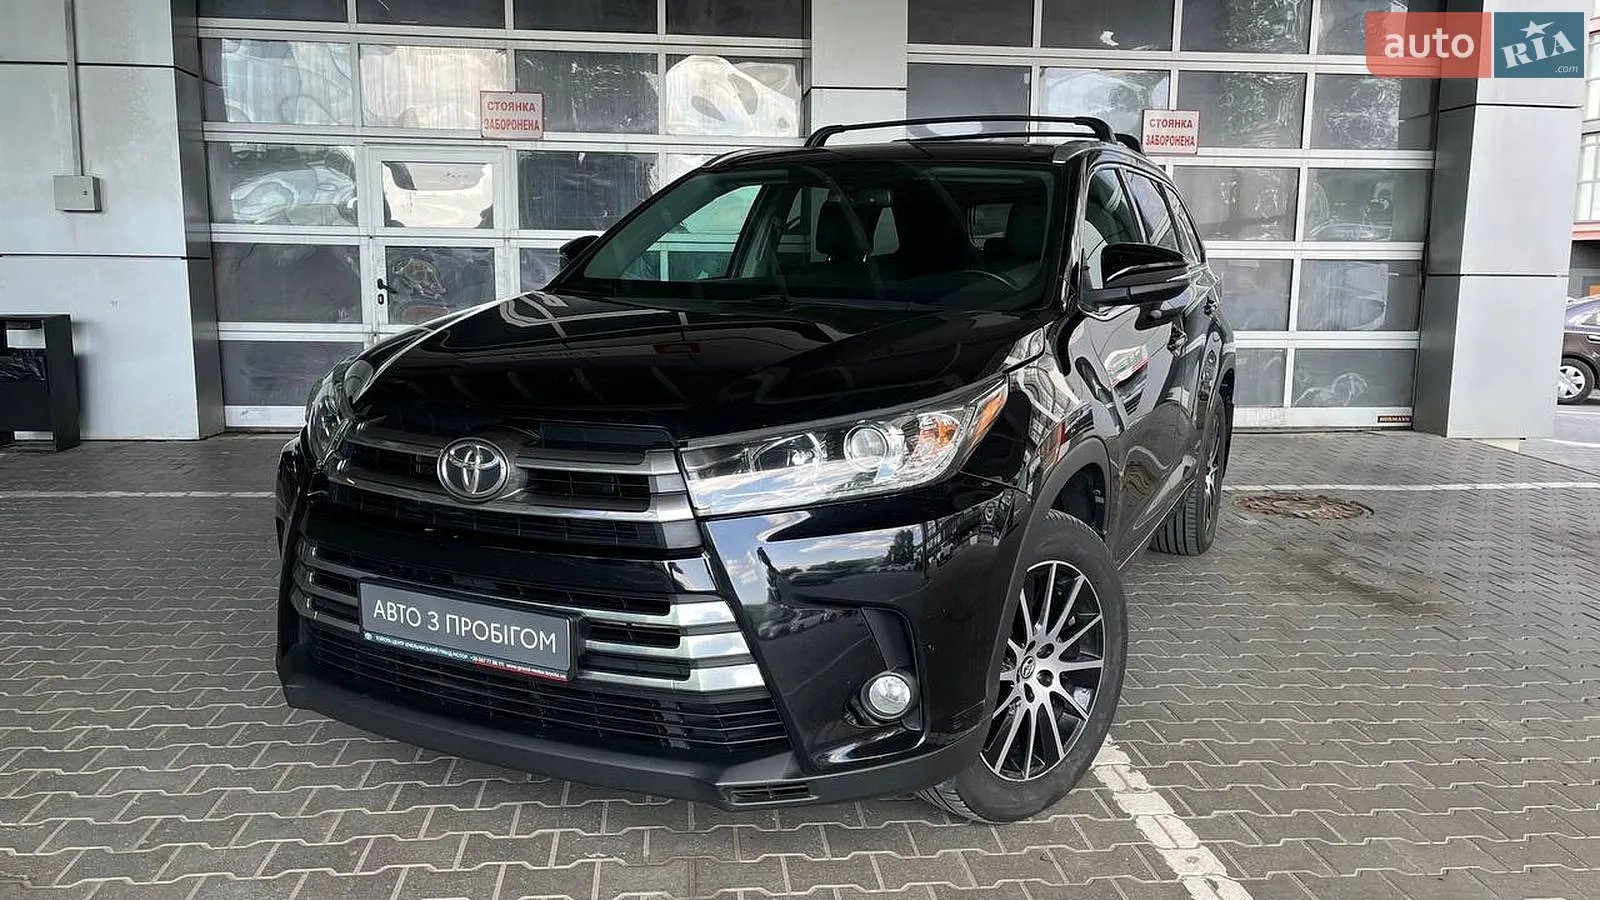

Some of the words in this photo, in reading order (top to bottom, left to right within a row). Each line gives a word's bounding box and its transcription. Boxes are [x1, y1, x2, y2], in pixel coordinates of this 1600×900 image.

[487, 101, 536, 112] СТОЯНКА
[484, 119, 540, 131] ЗАБОРОНЕНА
[1149, 118, 1193, 128] СТОЯНКА
[1145, 135, 1195, 147] ЗАБОРОНЕНА
[373, 599, 421, 628] АВТО
[427, 611, 440, 631] З
[446, 614, 556, 654] ПРОБІГОМ
